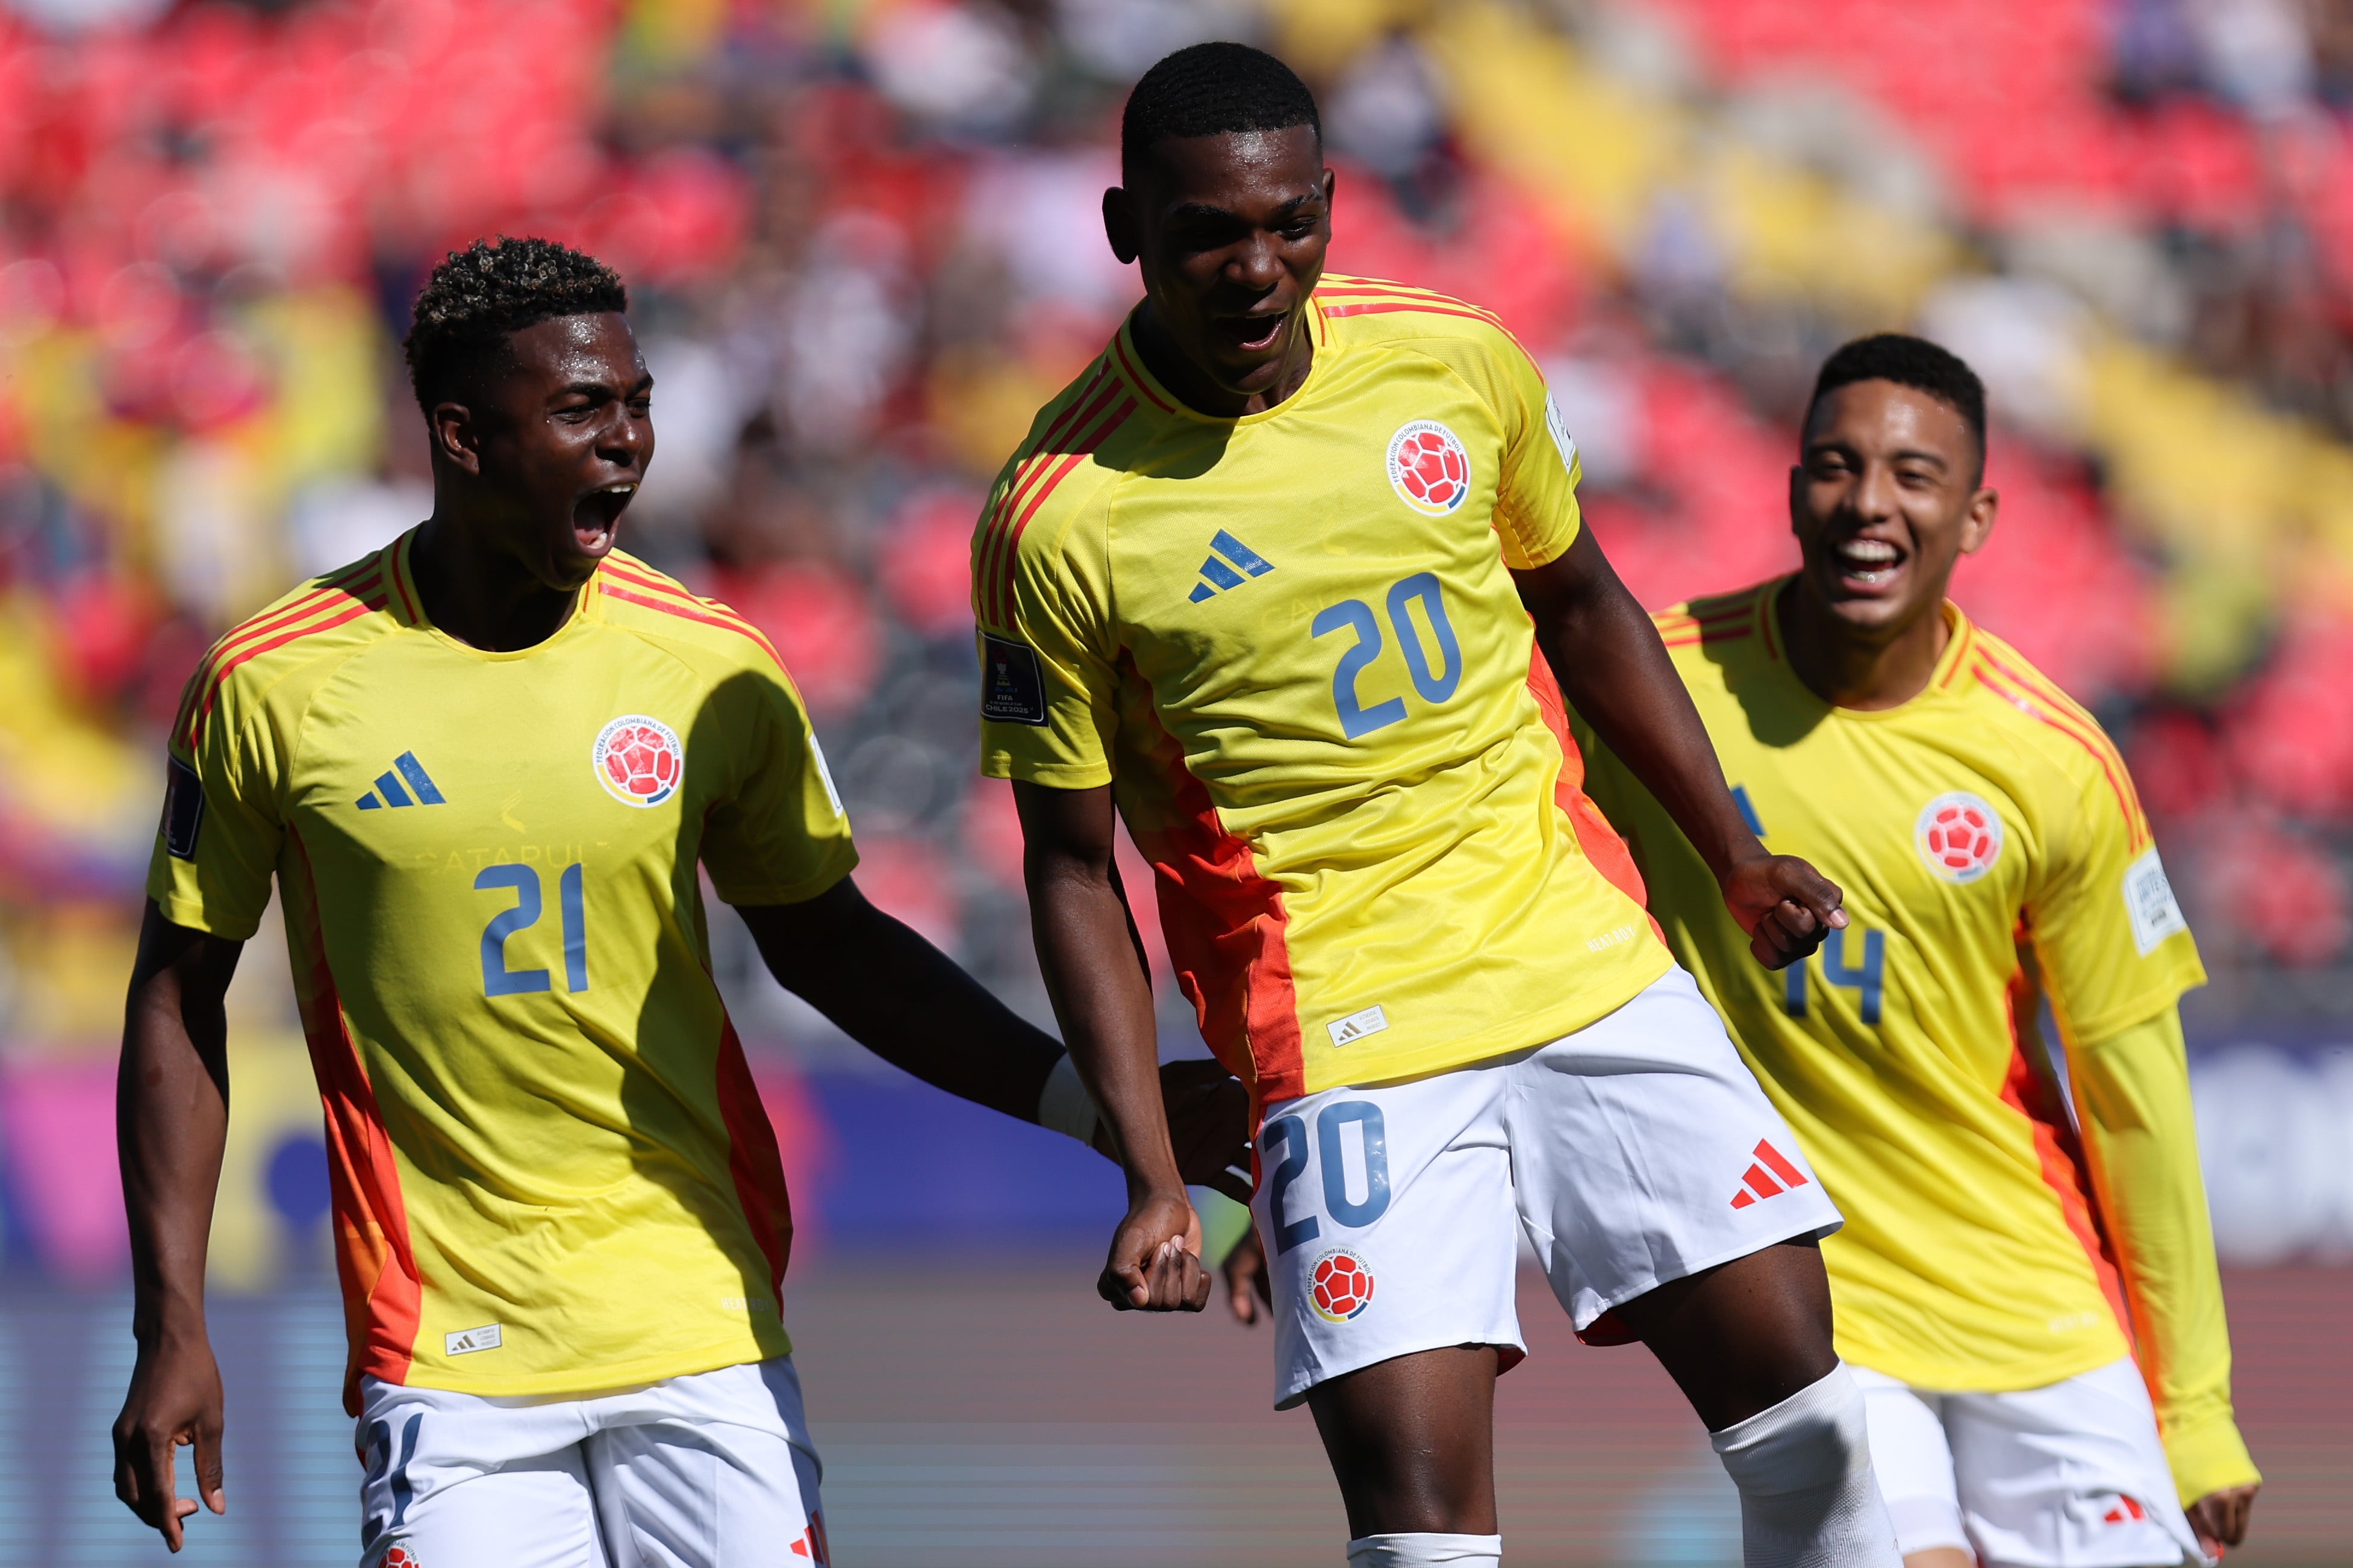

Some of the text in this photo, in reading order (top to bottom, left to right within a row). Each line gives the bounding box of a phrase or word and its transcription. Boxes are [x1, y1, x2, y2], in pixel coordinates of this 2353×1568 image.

[1396, 423, 1433, 443] COLOMBIANA
[1311, 571, 1462, 741] 20
[615, 718, 656, 729] COLOMBIANA
[473, 863, 588, 997] 21
[1786, 928, 1884, 1025] 14
[1264, 1101, 1391, 1257] 20
[1317, 1248, 1348, 1262] COLOMBIANA
